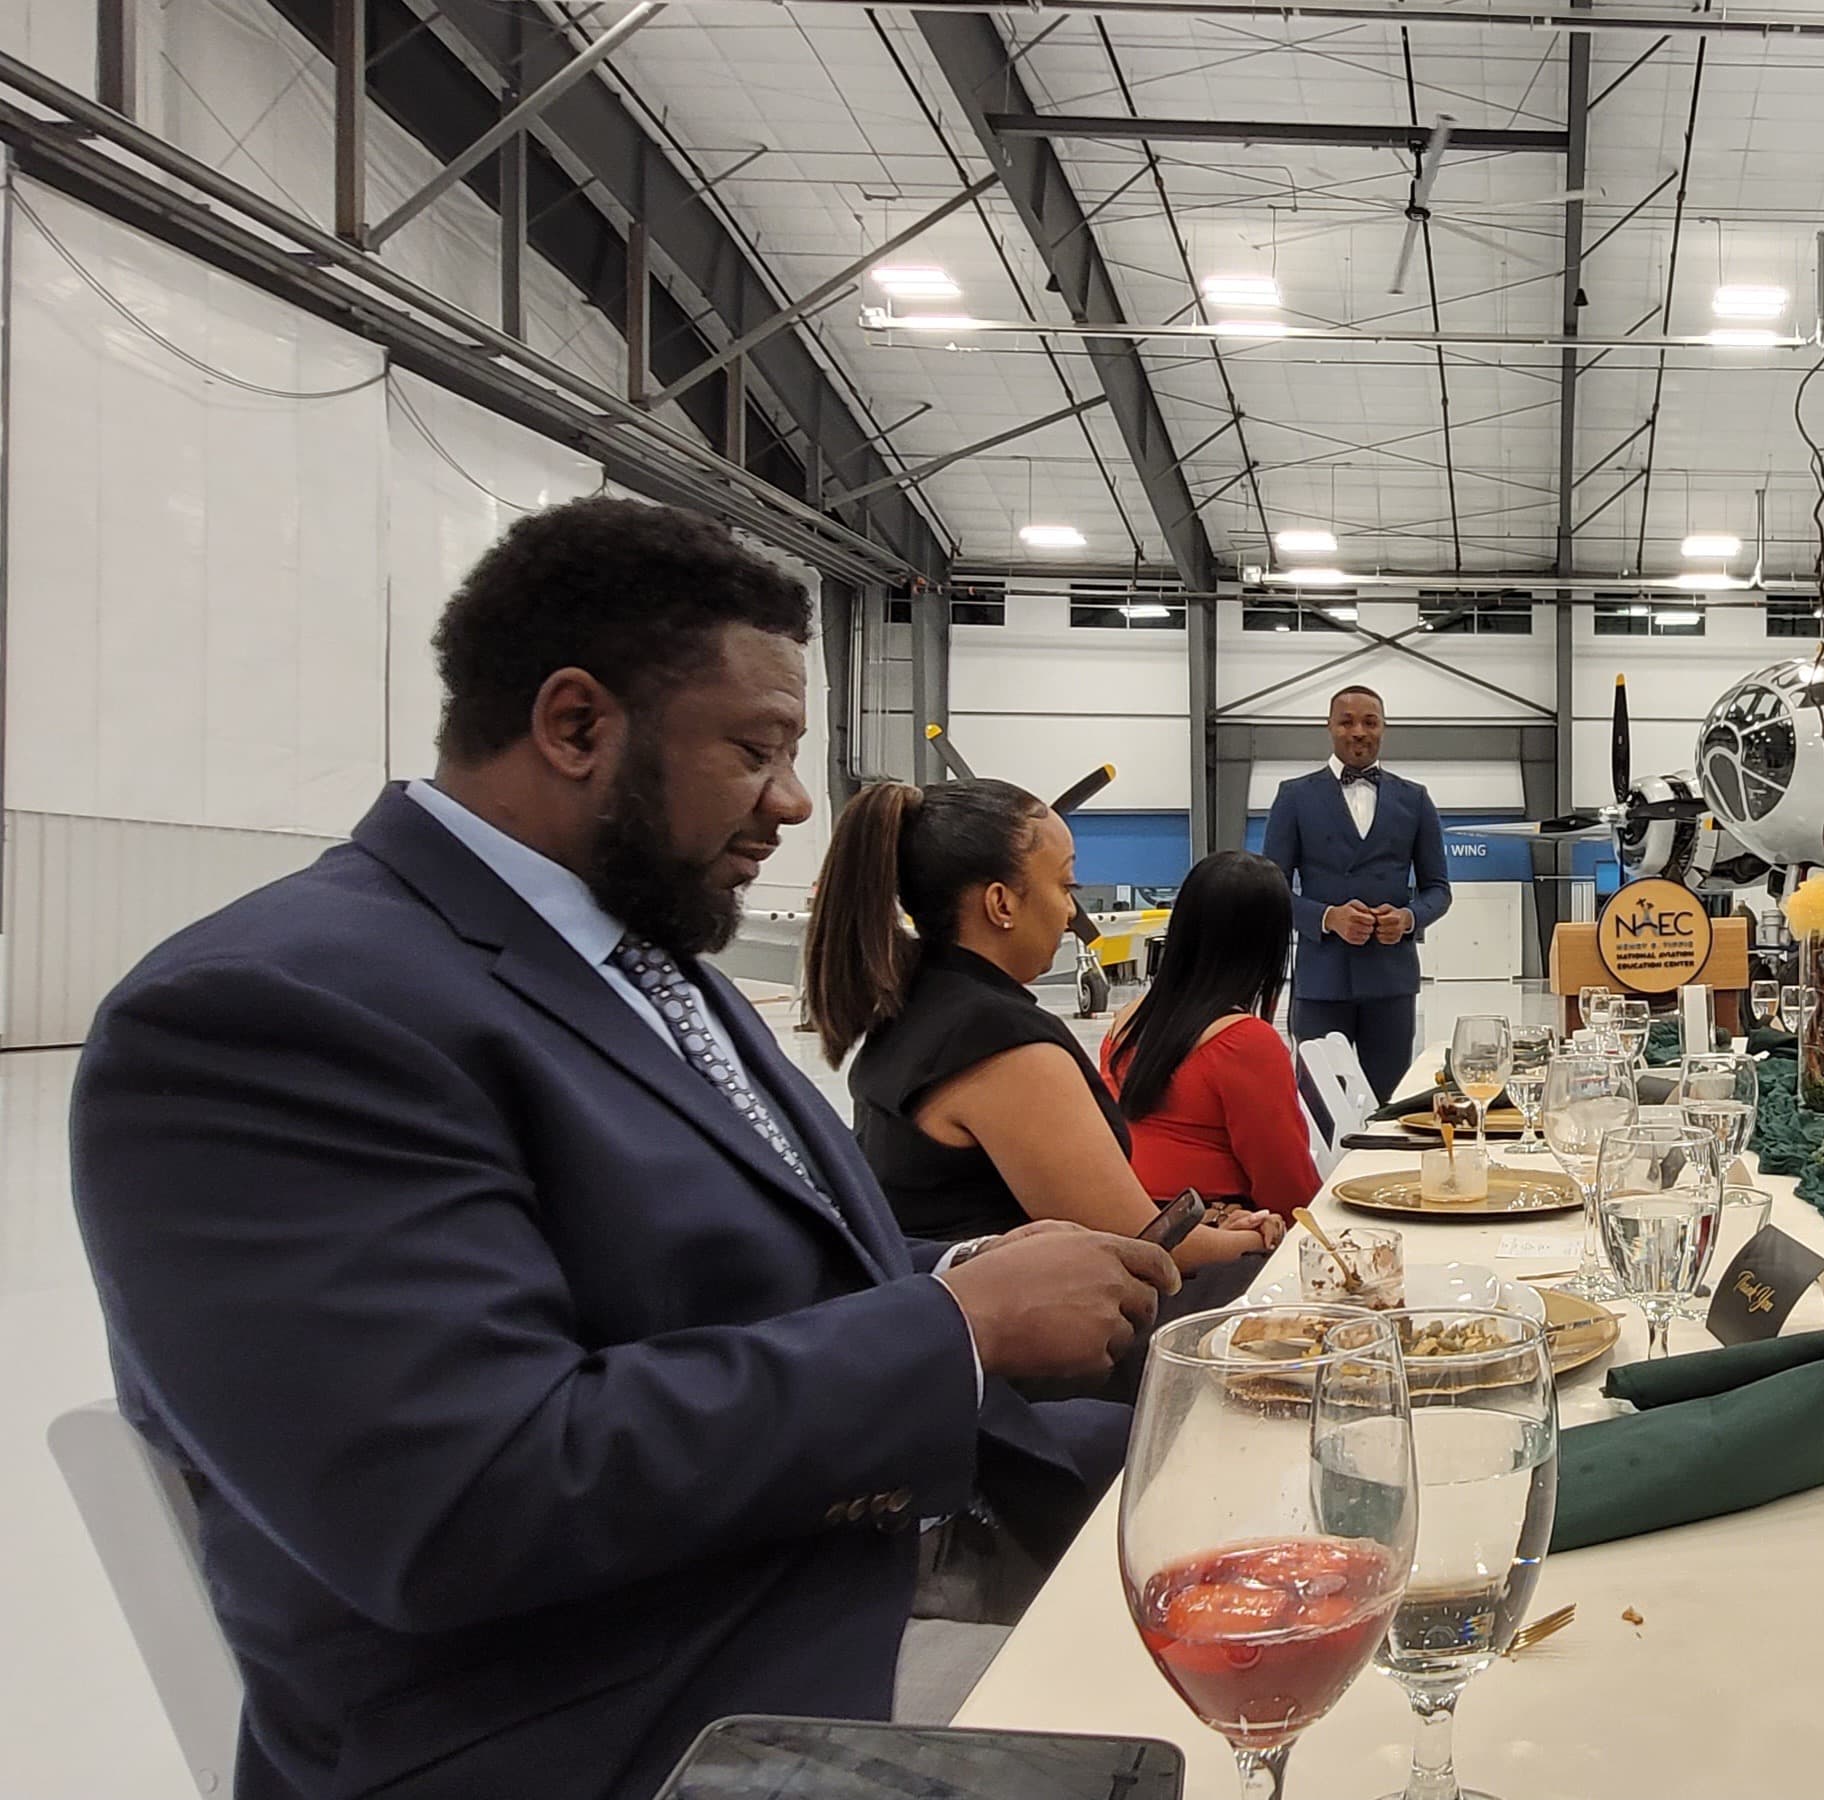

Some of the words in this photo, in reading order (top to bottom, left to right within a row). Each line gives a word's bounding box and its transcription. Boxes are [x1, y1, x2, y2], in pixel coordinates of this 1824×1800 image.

[1450, 844, 1487, 857] WING
[1616, 952, 1656, 960] NATIONAL
[1658, 951, 1694, 959] AVIATION
[1617, 961, 1662, 970] EDUCATION
[1664, 960, 1694, 968] CENTER
[1733, 1270, 1762, 1303] Thank
[1749, 1286, 1776, 1313] You
